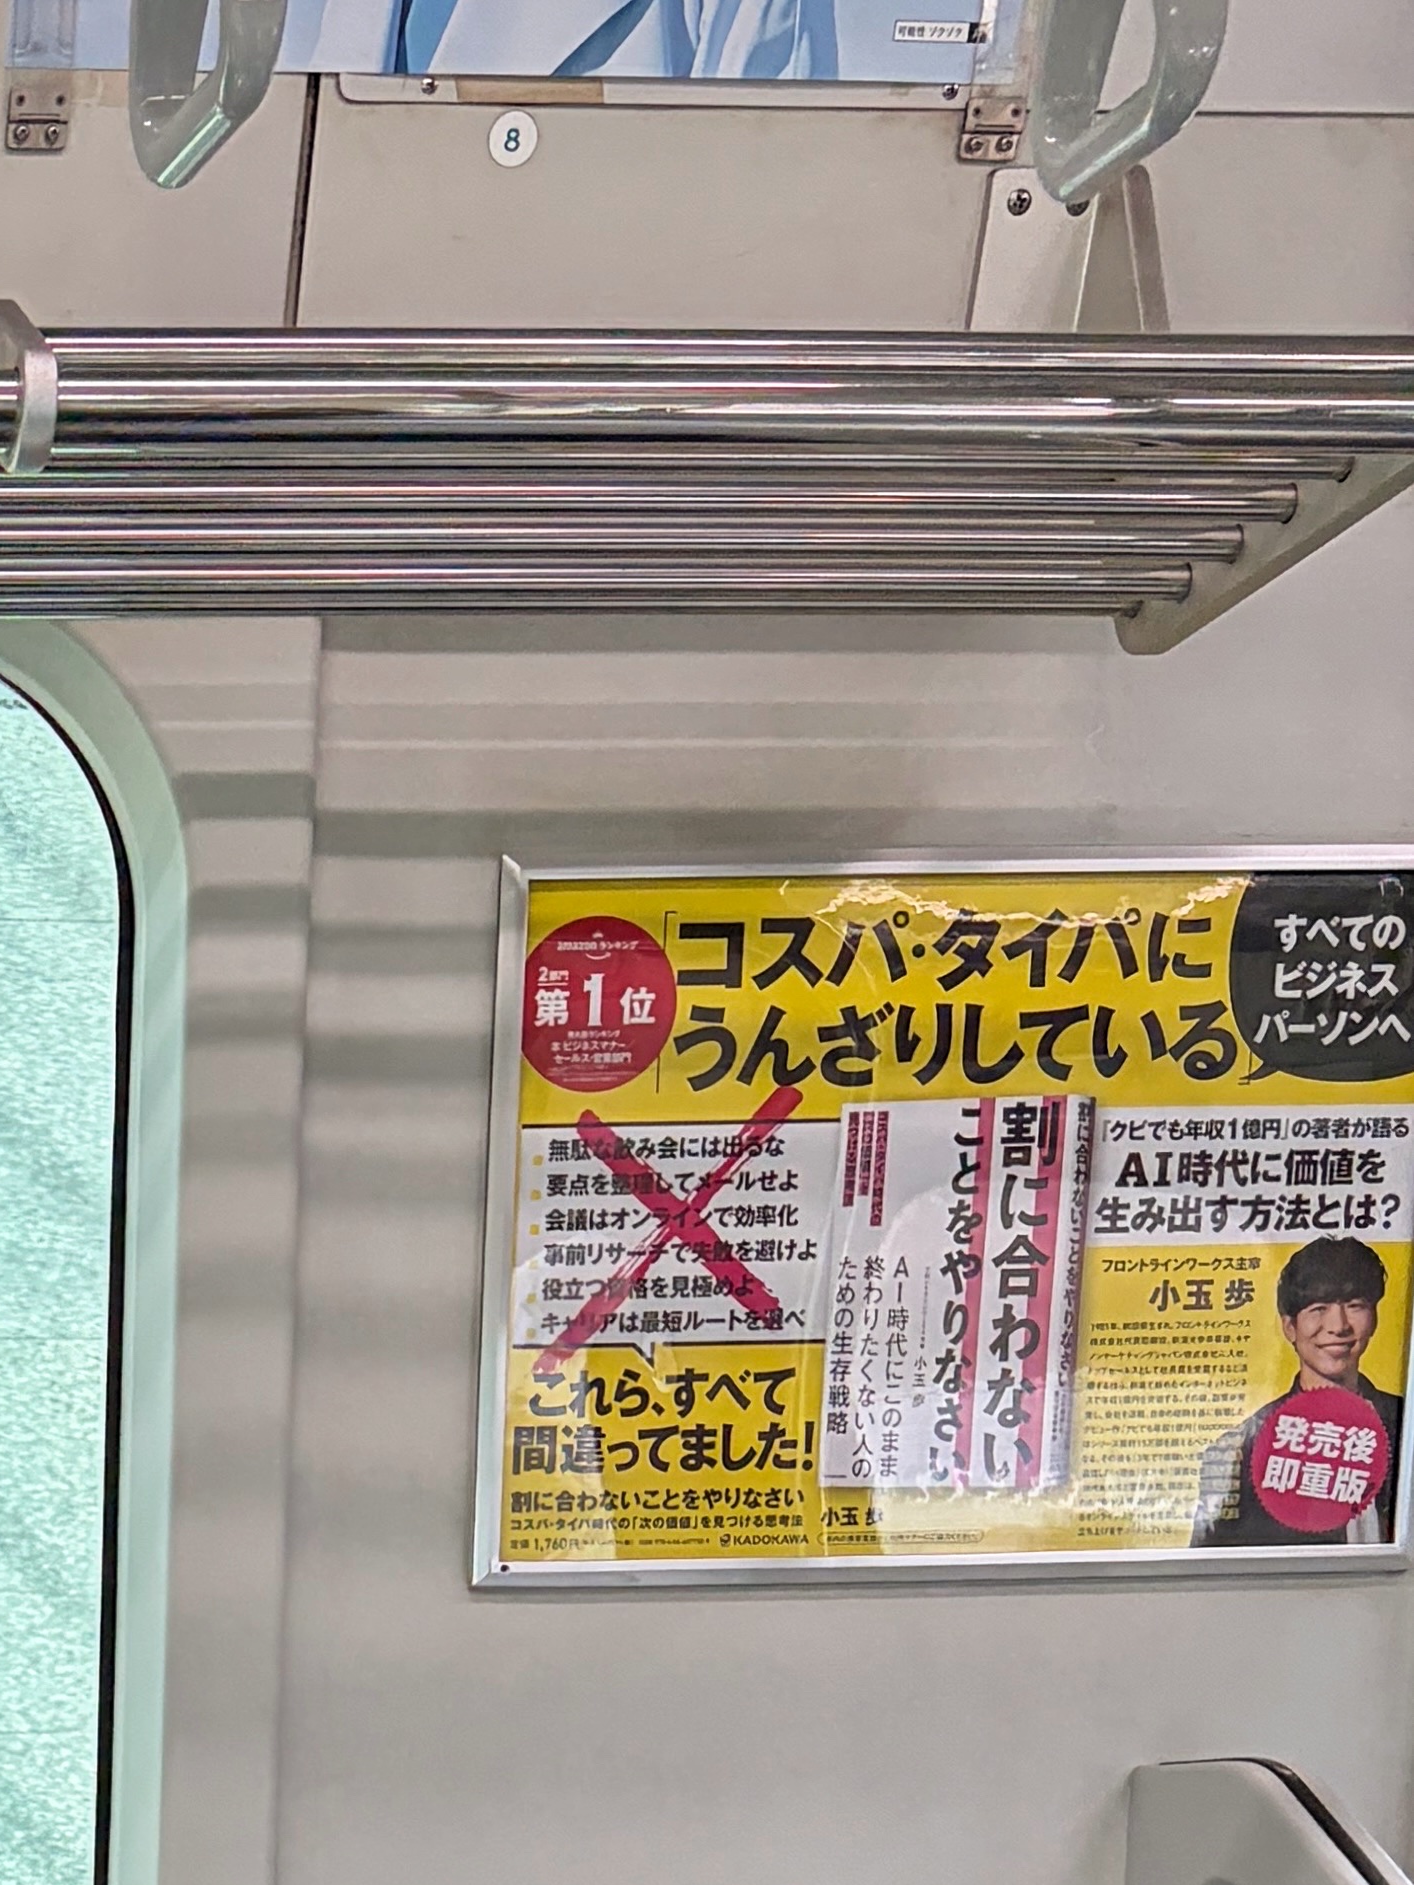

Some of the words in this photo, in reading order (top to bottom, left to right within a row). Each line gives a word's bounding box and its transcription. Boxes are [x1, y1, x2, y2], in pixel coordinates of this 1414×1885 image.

[504, 127, 521, 152] 8
[1274, 913, 1406, 953] すべての
[1274, 960, 1399, 1000] ビジネス
[1252, 1009, 1412, 1047] パーソンへ
[1115, 1149, 1386, 1188] AI時代に価値を
[1094, 1193, 1401, 1234] 生み出す方法とは?
[929, 1107, 984, 1482] ことをやりなさい
[983, 1101, 1060, 1484] 割に合わない
[1148, 1278, 1214, 1312] 小玉
[852, 1255, 886, 1478] 終わりたくない人の
[528, 1367, 796, 1418] これら、すべて
[512, 1421, 815, 1475] 間違ってました!
[1272, 1414, 1378, 1465] 発売後
[511, 1487, 804, 1513] 割に合わないことをやりなさい
[1261, 1455, 1371, 1505] 即重版
[733, 1533, 809, 1547] KADOKAWA
